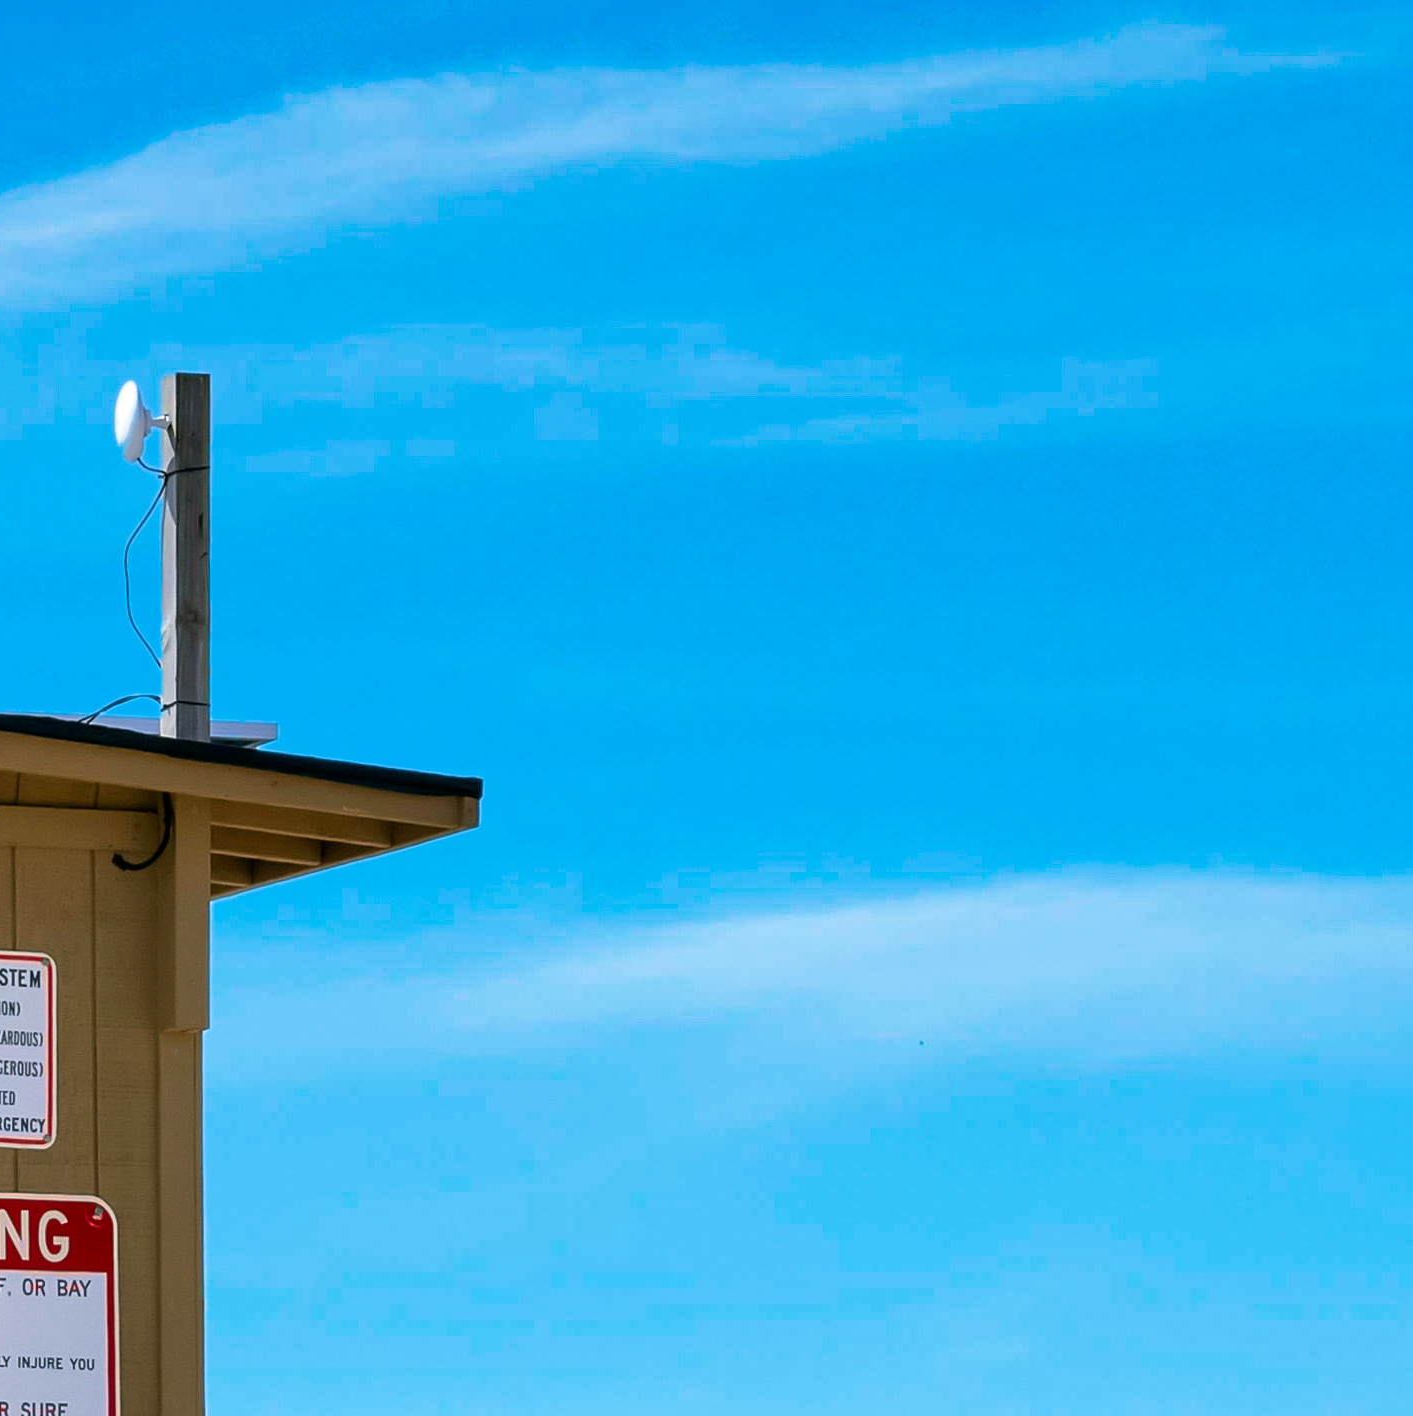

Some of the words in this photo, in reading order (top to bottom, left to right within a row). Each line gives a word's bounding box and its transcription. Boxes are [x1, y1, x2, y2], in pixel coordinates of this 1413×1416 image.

[22, 1278, 46, 1296] OR
[57, 1280, 92, 1298] BAY
[18, 1357, 63, 1369] INJURE
[70, 1358, 95, 1371] YOU
